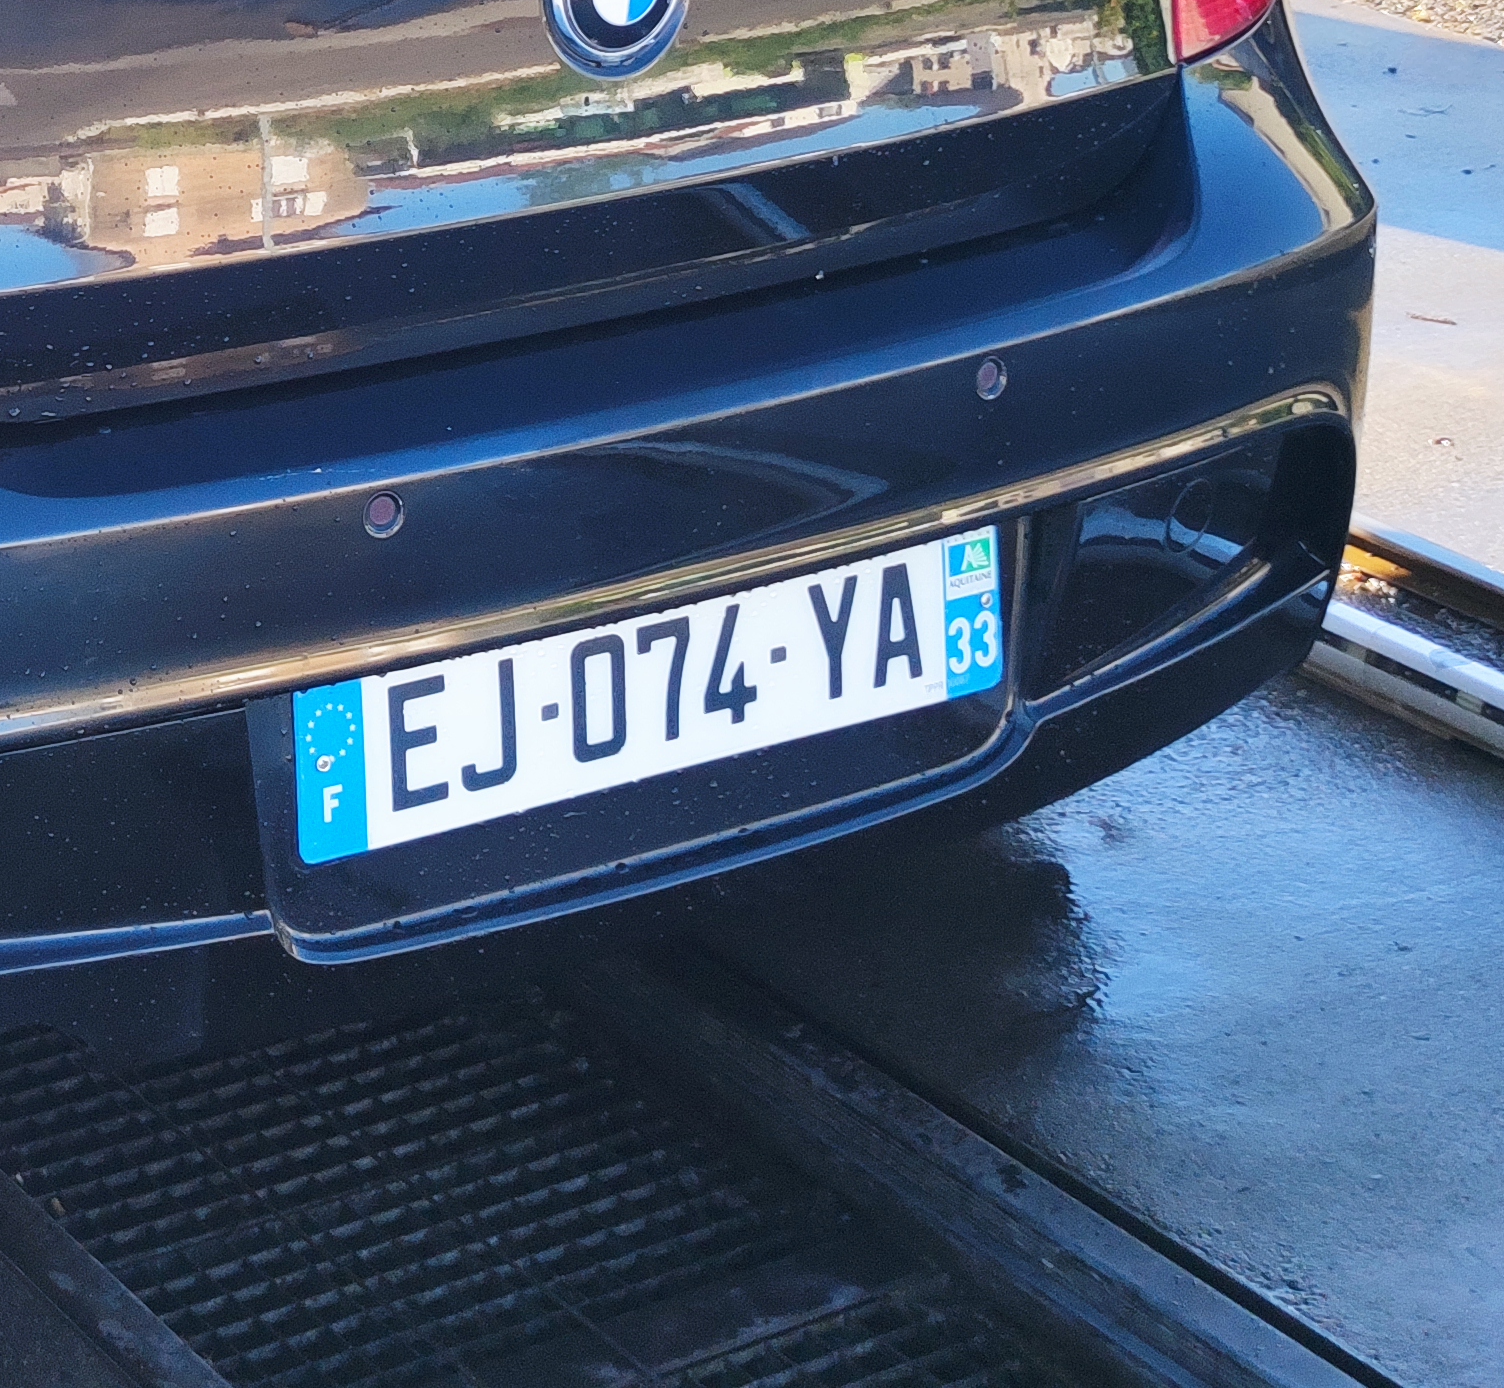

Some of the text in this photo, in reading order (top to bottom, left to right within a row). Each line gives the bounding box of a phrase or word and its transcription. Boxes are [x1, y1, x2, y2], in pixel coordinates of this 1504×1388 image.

[949, 570, 992, 588] AQUITAINE
[947, 610, 998, 674] 33
[387, 563, 924, 813] EJ-074-YA
[323, 783, 344, 824] F
